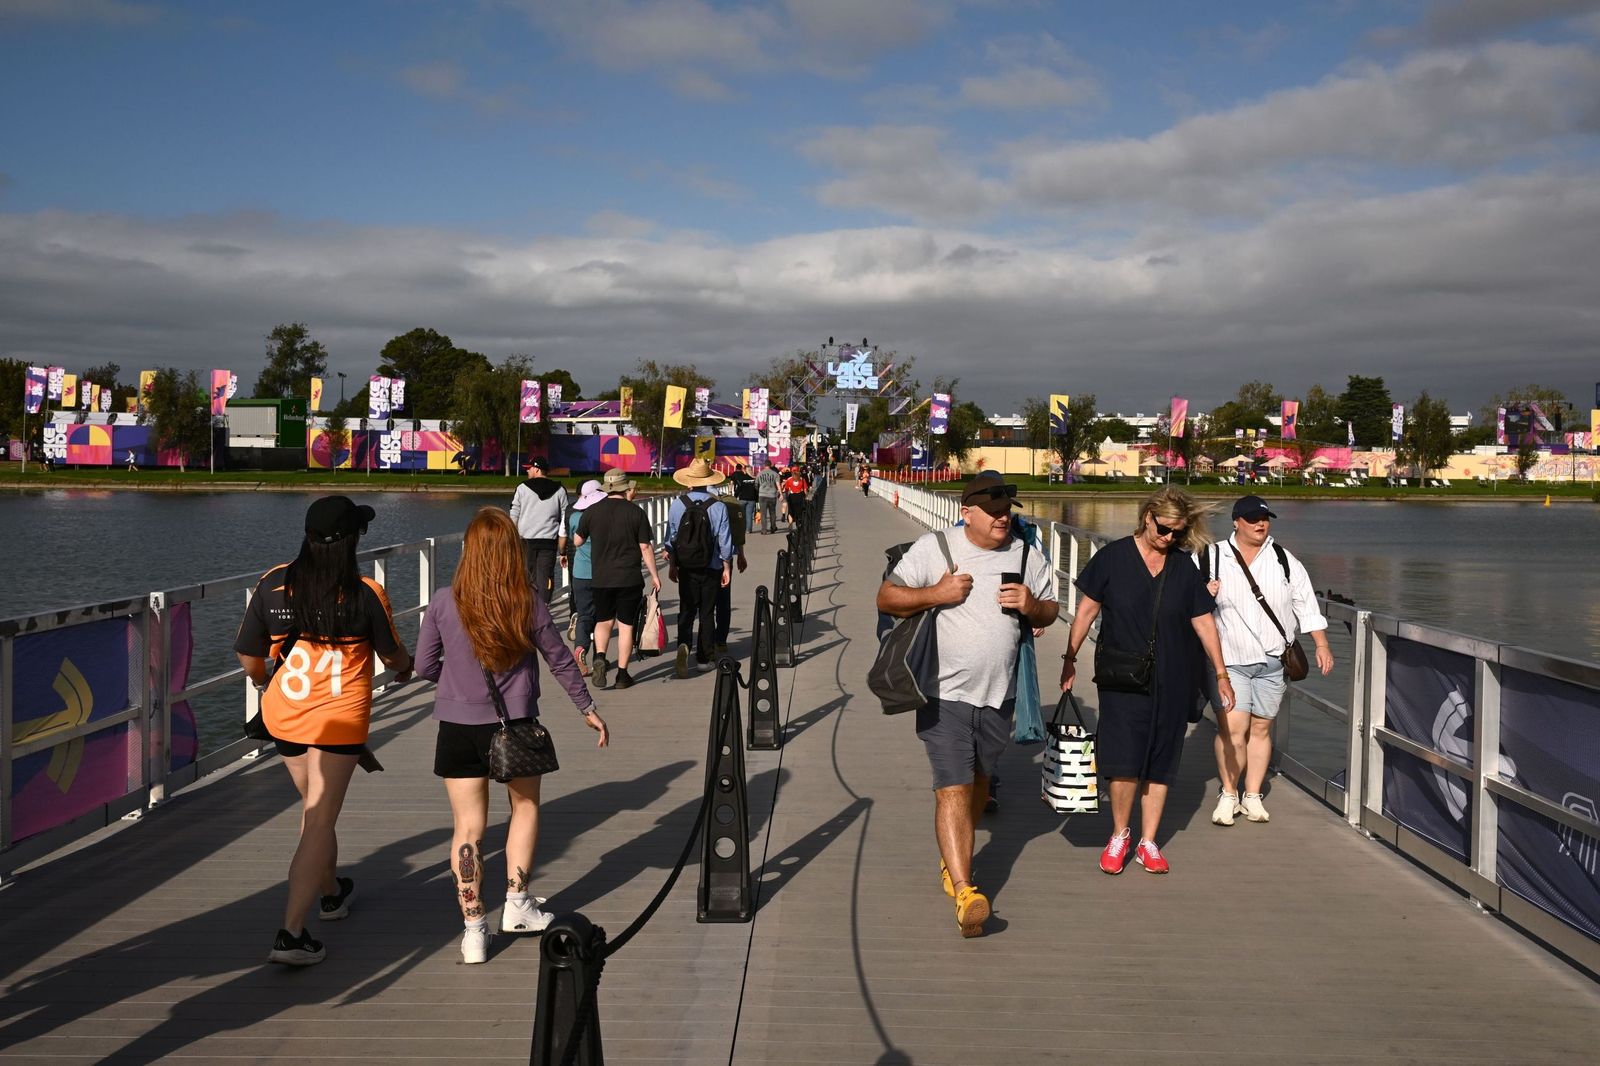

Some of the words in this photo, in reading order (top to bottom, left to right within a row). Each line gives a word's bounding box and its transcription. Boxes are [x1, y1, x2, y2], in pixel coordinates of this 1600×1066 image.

[828, 362, 873, 377] LAKE
[837, 376, 879, 389] SIDE
[369, 381, 381, 419] LAKE
[380, 377, 391, 412] SIDE
[391, 383, 399, 410] LAKE
[749, 393, 759, 429] LAKE
[758, 388, 769, 422] SIDE
[390, 430, 401, 464] SIDE
[768, 414, 780, 457] LAKE
[779, 410, 791, 449] SIDE
[380, 434, 391, 469] LAKE
[281, 646, 343, 700] 81
